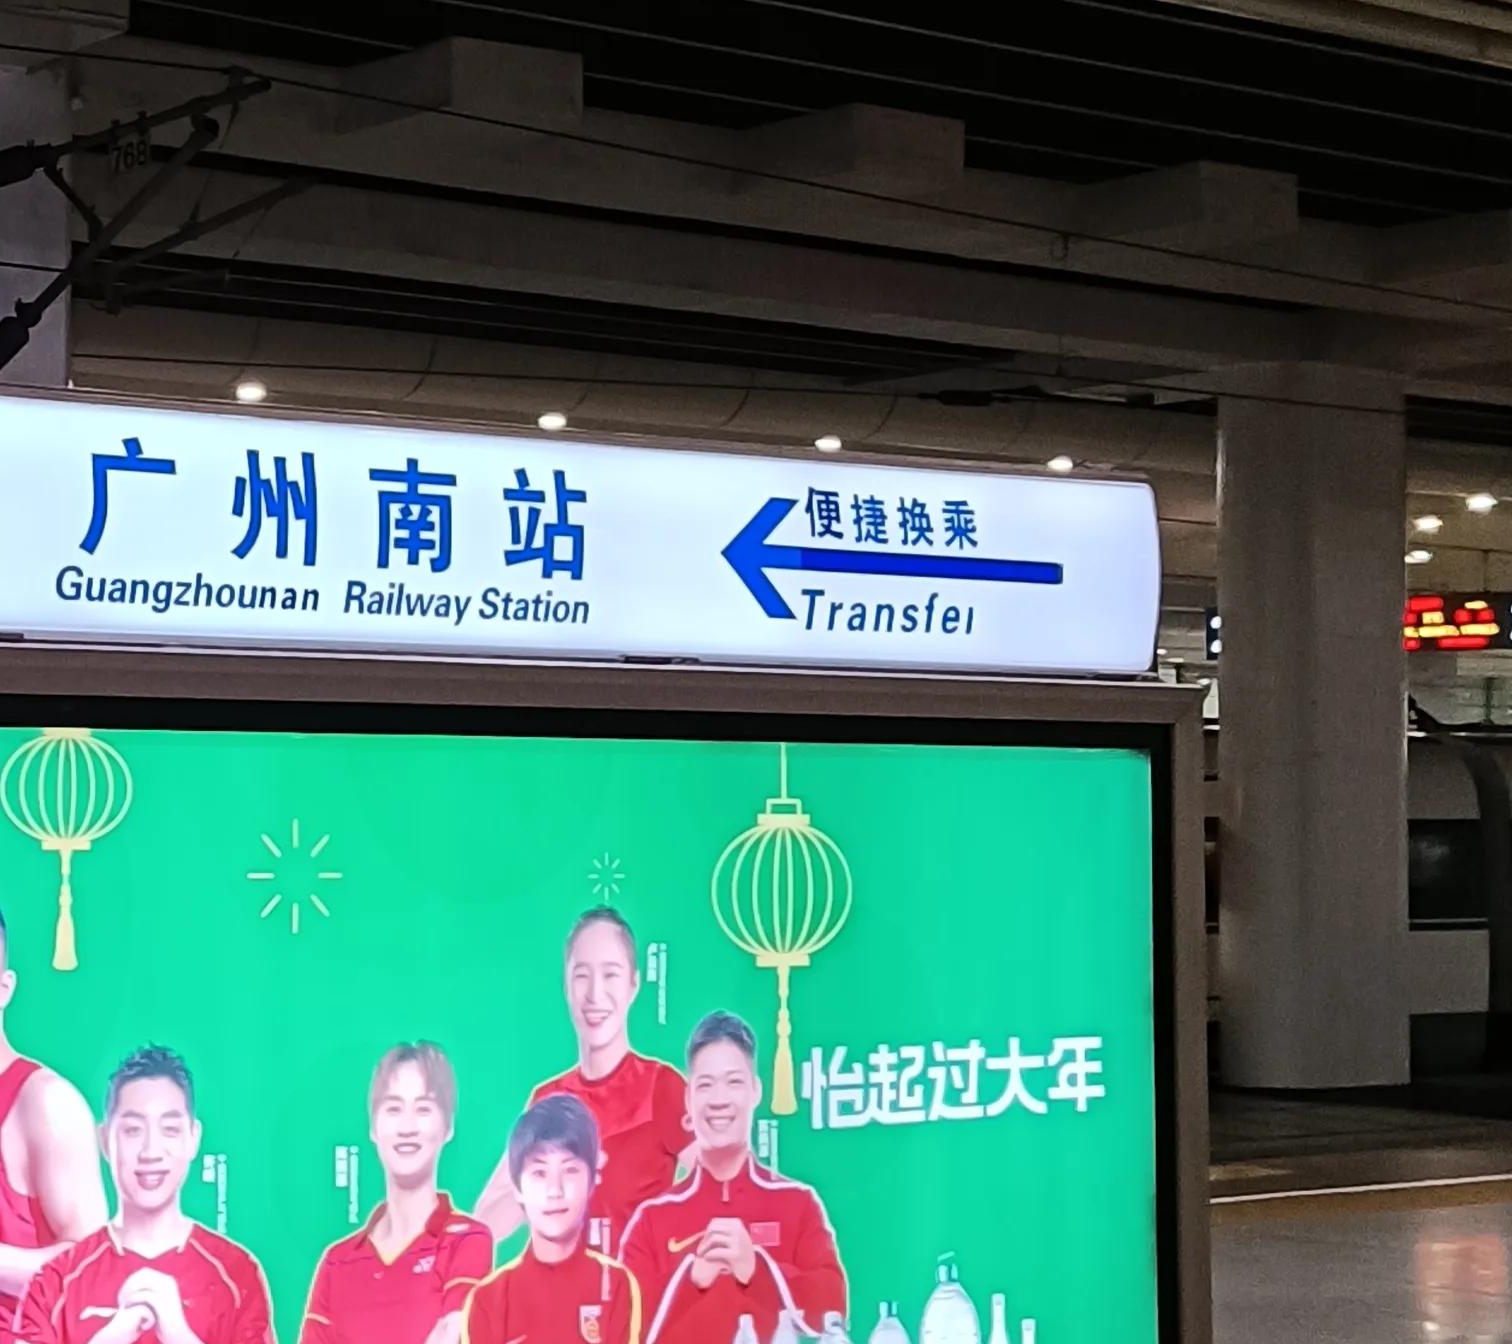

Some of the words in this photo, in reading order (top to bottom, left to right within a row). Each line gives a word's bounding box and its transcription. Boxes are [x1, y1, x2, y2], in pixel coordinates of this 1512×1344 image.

[112, 140, 147, 173] 768
[79, 436, 588, 581] 广州南站
[804, 486, 979, 549] 便捷换乘
[55, 565, 320, 614] Guangzhounan
[344, 580, 471, 626] Railway
[478, 587, 590, 625] Station
[801, 1036, 1106, 1130] 怡起过大年
